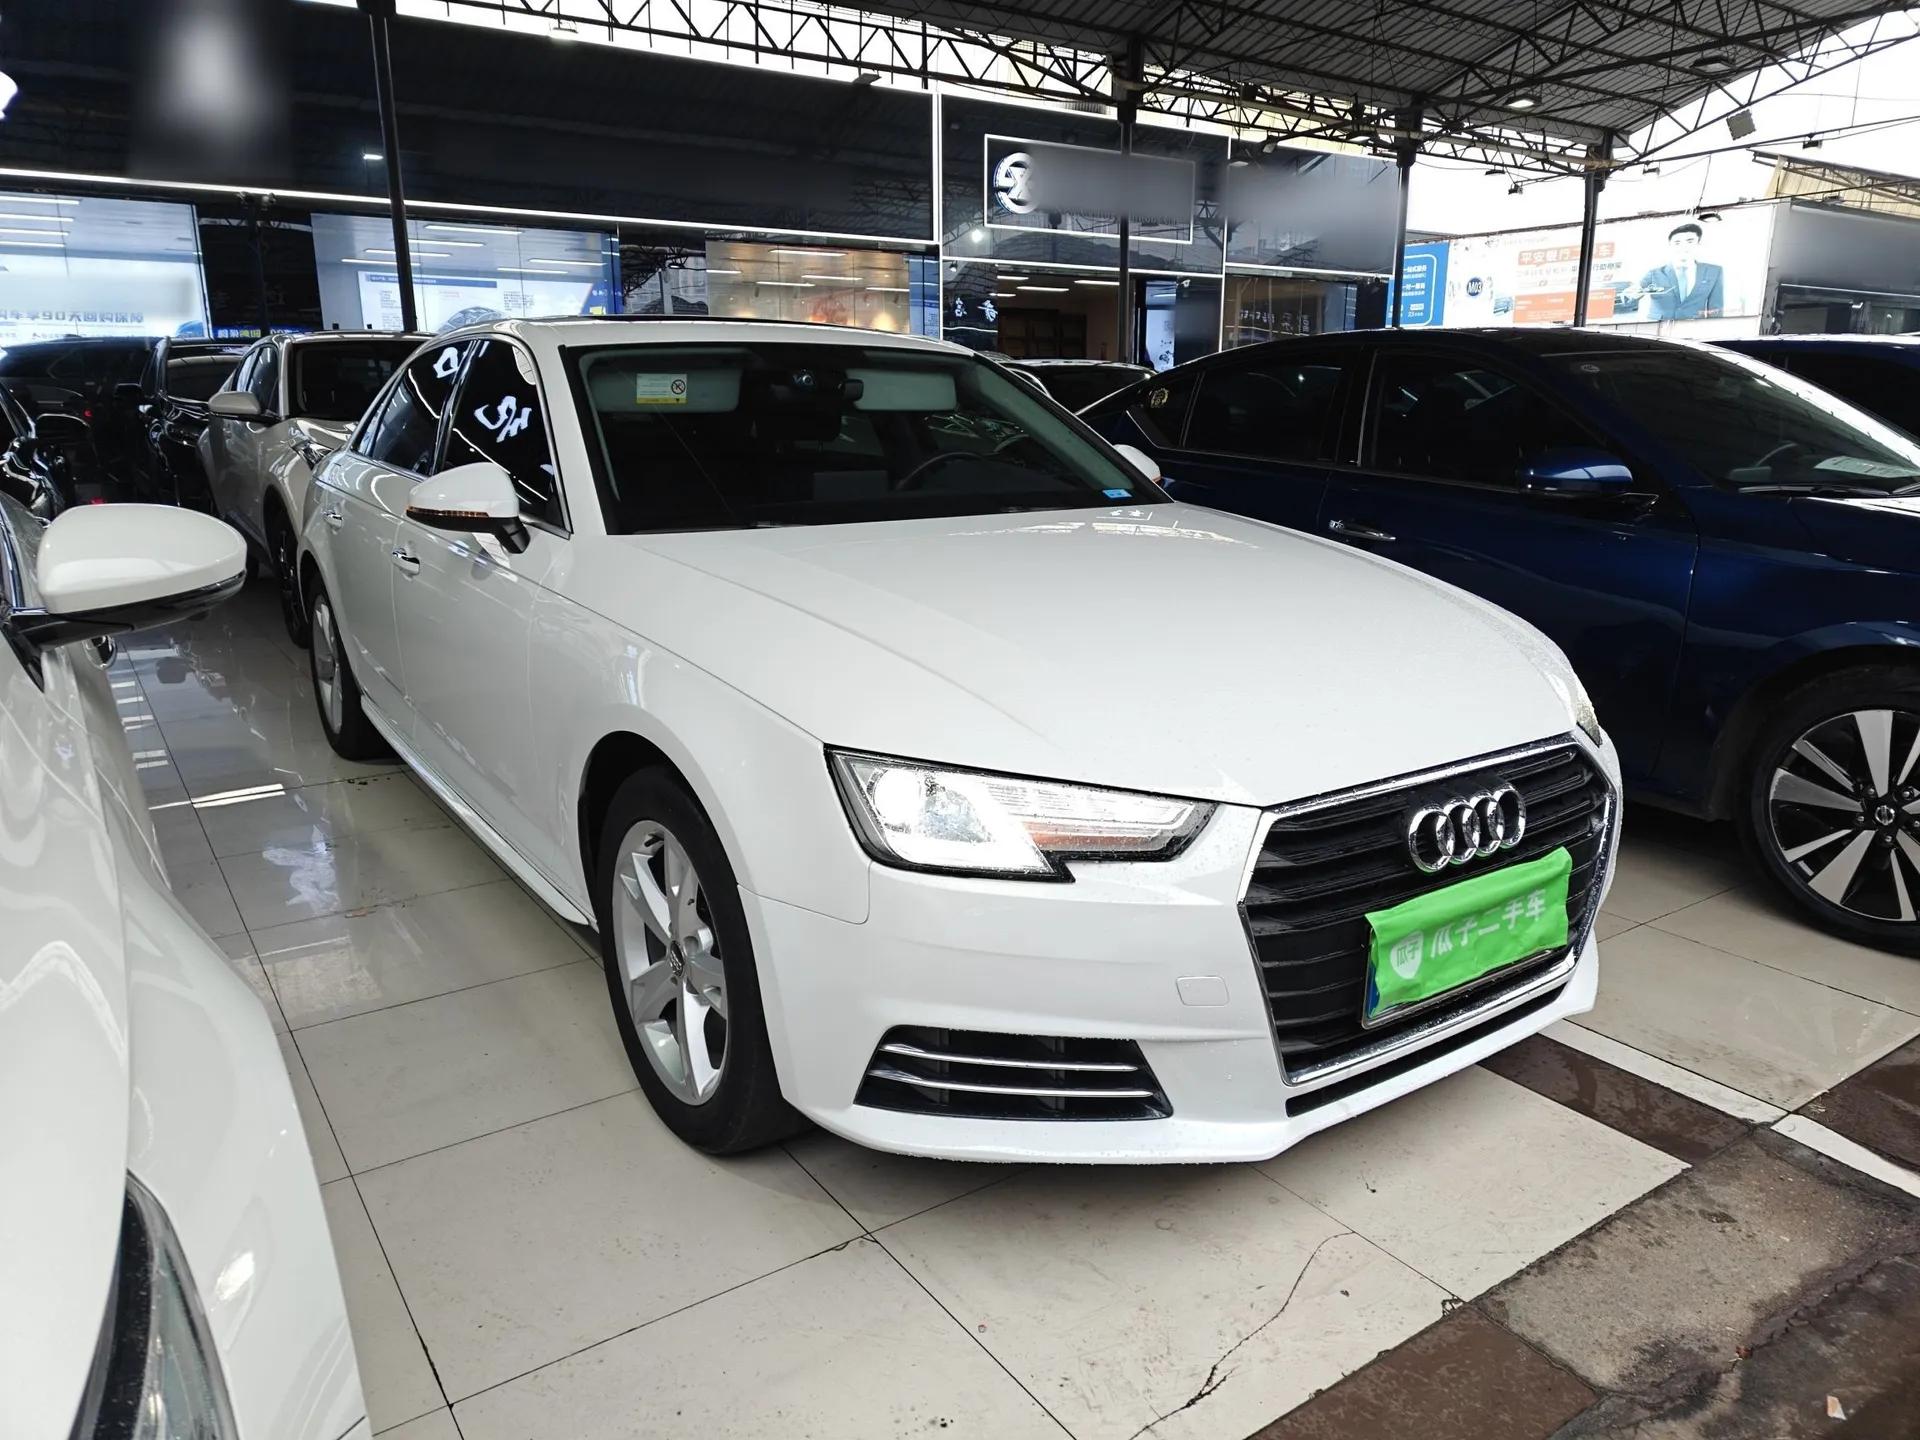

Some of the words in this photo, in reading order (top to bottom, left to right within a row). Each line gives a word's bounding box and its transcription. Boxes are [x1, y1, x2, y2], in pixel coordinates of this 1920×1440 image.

[1520, 244, 1611, 264] 平安银行二车
[1467, 281, 1483, 294] M03
[1430, 889, 1546, 958] 瓜子二手车
